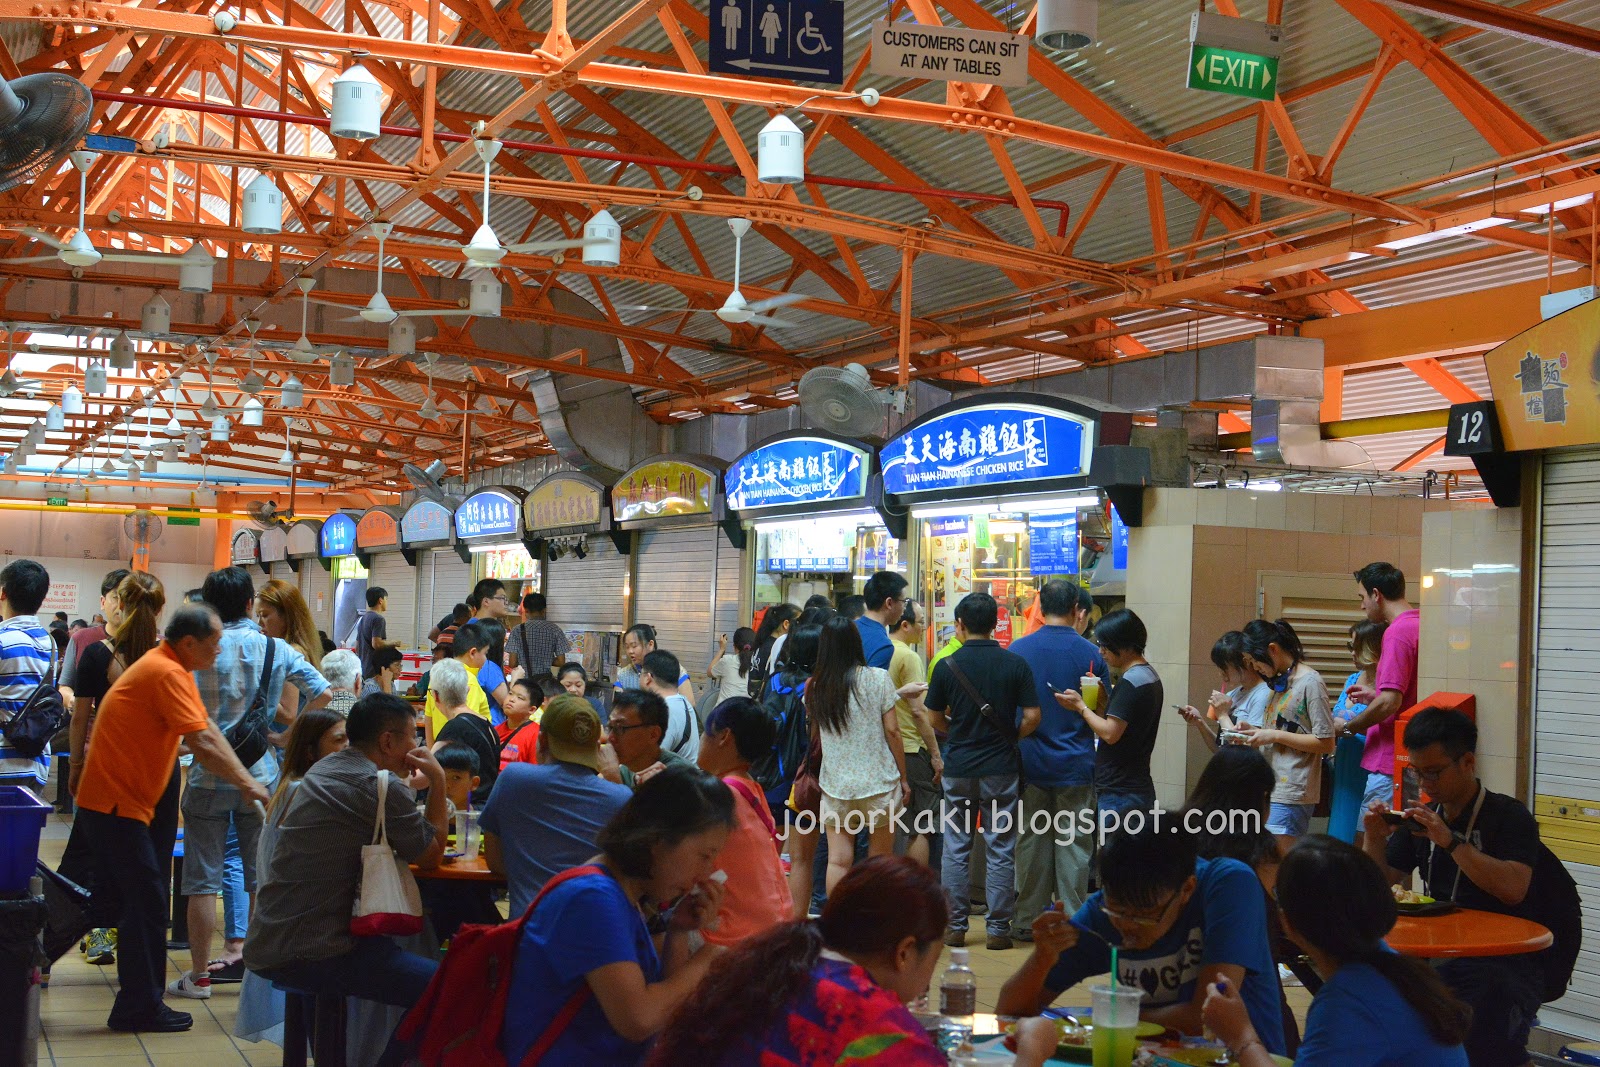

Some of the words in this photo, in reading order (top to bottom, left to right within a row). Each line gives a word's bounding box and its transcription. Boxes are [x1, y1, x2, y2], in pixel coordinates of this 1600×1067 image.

[883, 30, 965, 53] CUSTOMERS
[968, 39, 996, 55] CAN
[999, 42, 1020, 57] SIT
[900, 53, 917, 68] AT
[921, 55, 949, 71] ANY
[953, 58, 1001, 76] TABLES
[1208, 54, 1260, 90] EXIT
[1457, 410, 1484, 444] 12
[905, 473, 920, 484] TIAN
[920, 471, 936, 482] TIAN
[936, 467, 975, 480] HAINANESE
[975, 463, 1008, 476] CHICKEN
[1008, 460, 1024, 472] RICE
[811, 482, 823, 492] RICE
